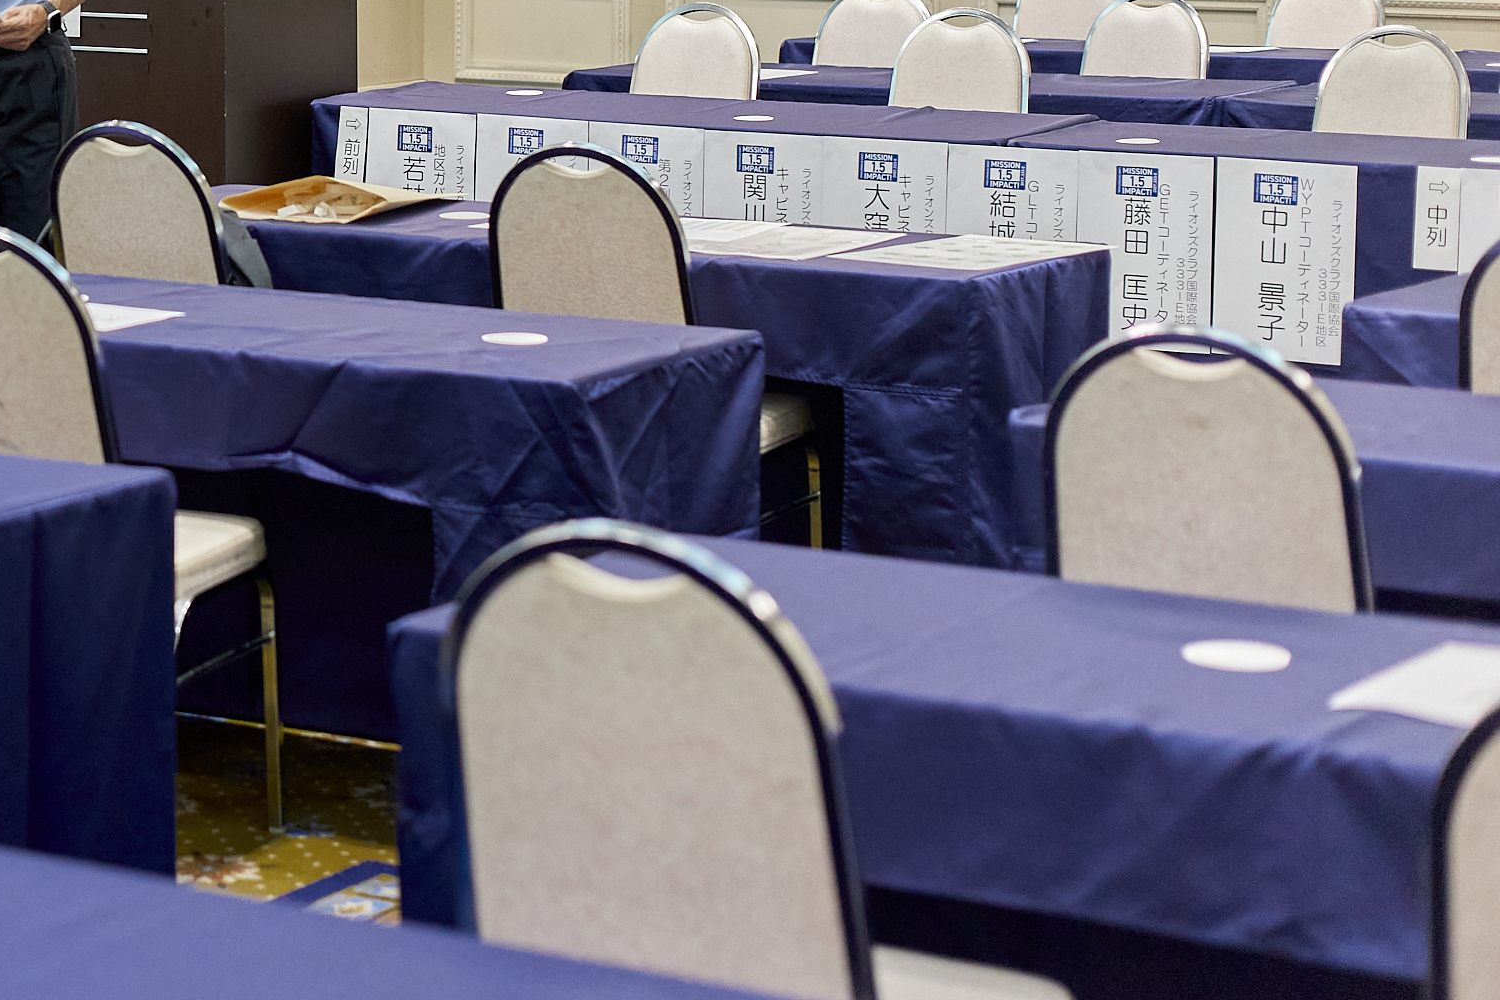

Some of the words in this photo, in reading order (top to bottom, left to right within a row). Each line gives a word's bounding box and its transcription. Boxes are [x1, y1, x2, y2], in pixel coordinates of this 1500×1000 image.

[409, 133, 422, 144] 1.5
[513, 129, 539, 137] MISSION
[519, 136, 533, 147] 1.5
[627, 136, 654, 144] MISSION
[633, 144, 647, 155] 1.5
[742, 146, 769, 154] MISSION
[342, 138, 361, 175] 前列
[749, 154, 762, 165] 1.5
[864, 153, 893, 162] MISSION
[871, 161, 886, 173] 1.5
[990, 160, 1021, 169] MISSION
[998, 169, 1013, 181] 1.5
[1122, 167, 1153, 176] MISSION
[1129, 175, 1145, 188] 1.5
[1260, 174, 1293, 184] MISSION
[1267, 183, 1285, 196] 1.5
[1026, 180, 1040, 240] GLTコ
[1052, 184, 1065, 241] ライオンズ
[1123, 197, 1152, 255] 藤田
[1426, 204, 1448, 248] 中列
[1260, 206, 1288, 265] 中山
[1186, 190, 1199, 326] ライオンズクラブ国際協会
[1328, 200, 1343, 337] ライオンズクラブ国際協会
[1257, 282, 1286, 341] 景子
